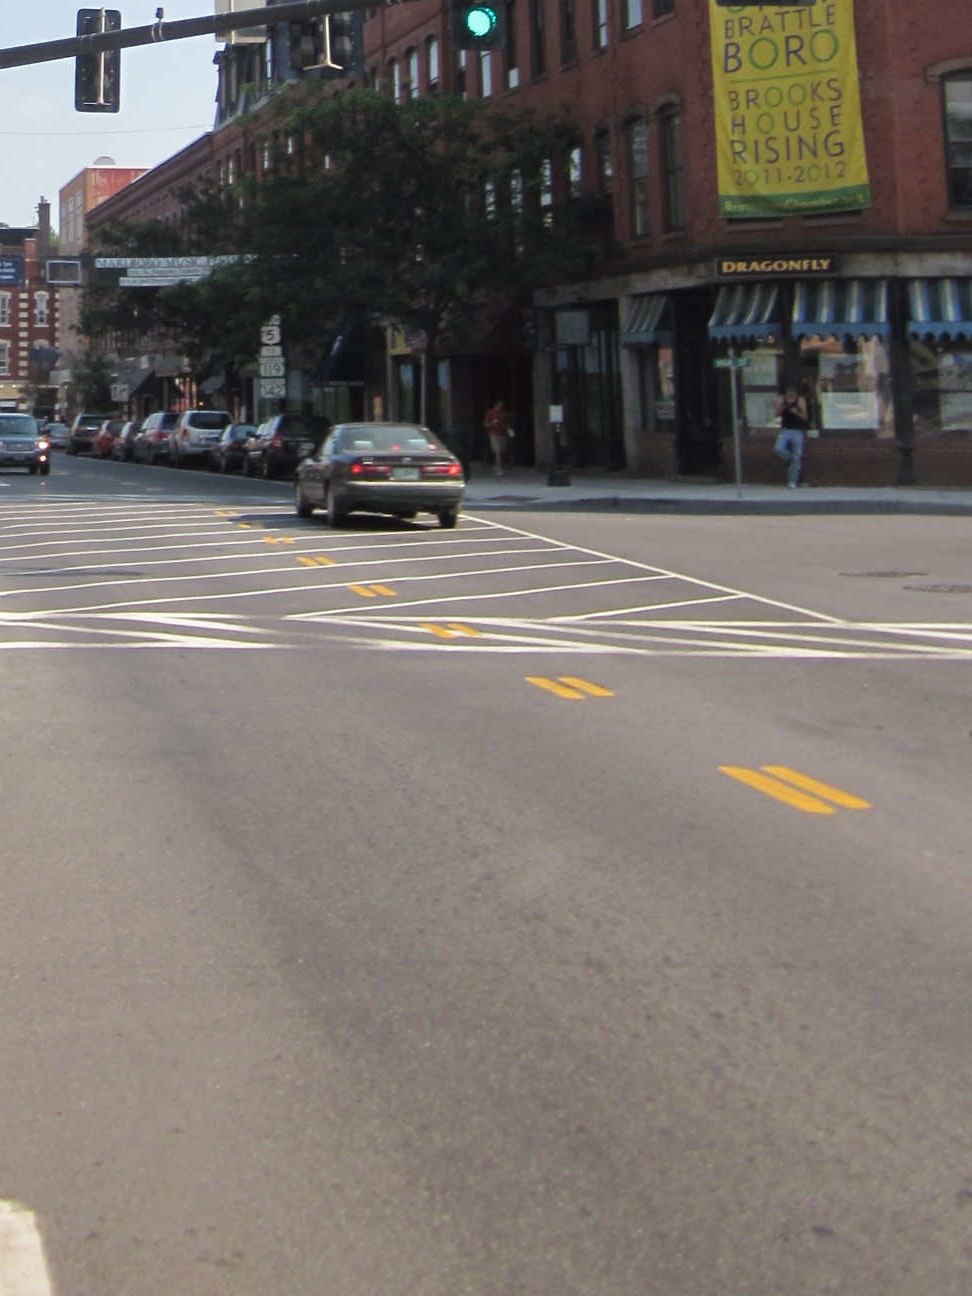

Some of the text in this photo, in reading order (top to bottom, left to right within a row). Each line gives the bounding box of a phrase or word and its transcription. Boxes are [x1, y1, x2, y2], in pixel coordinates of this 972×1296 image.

[724, 4, 836, 40] BRATTLE
[724, 29, 839, 74] BORO
[728, 78, 843, 111] BROOKS
[731, 105, 842, 136] HOUSE
[731, 130, 845, 165] RISING
[735, 161, 846, 186] 2011-2012
[97, 258, 159, 268] MARLBORO
[721, 258, 831, 274] DRAGONFLY
[267, 329, 275, 341] 5
[264, 364, 280, 375] 119
[265, 386, 283, 397] 142
